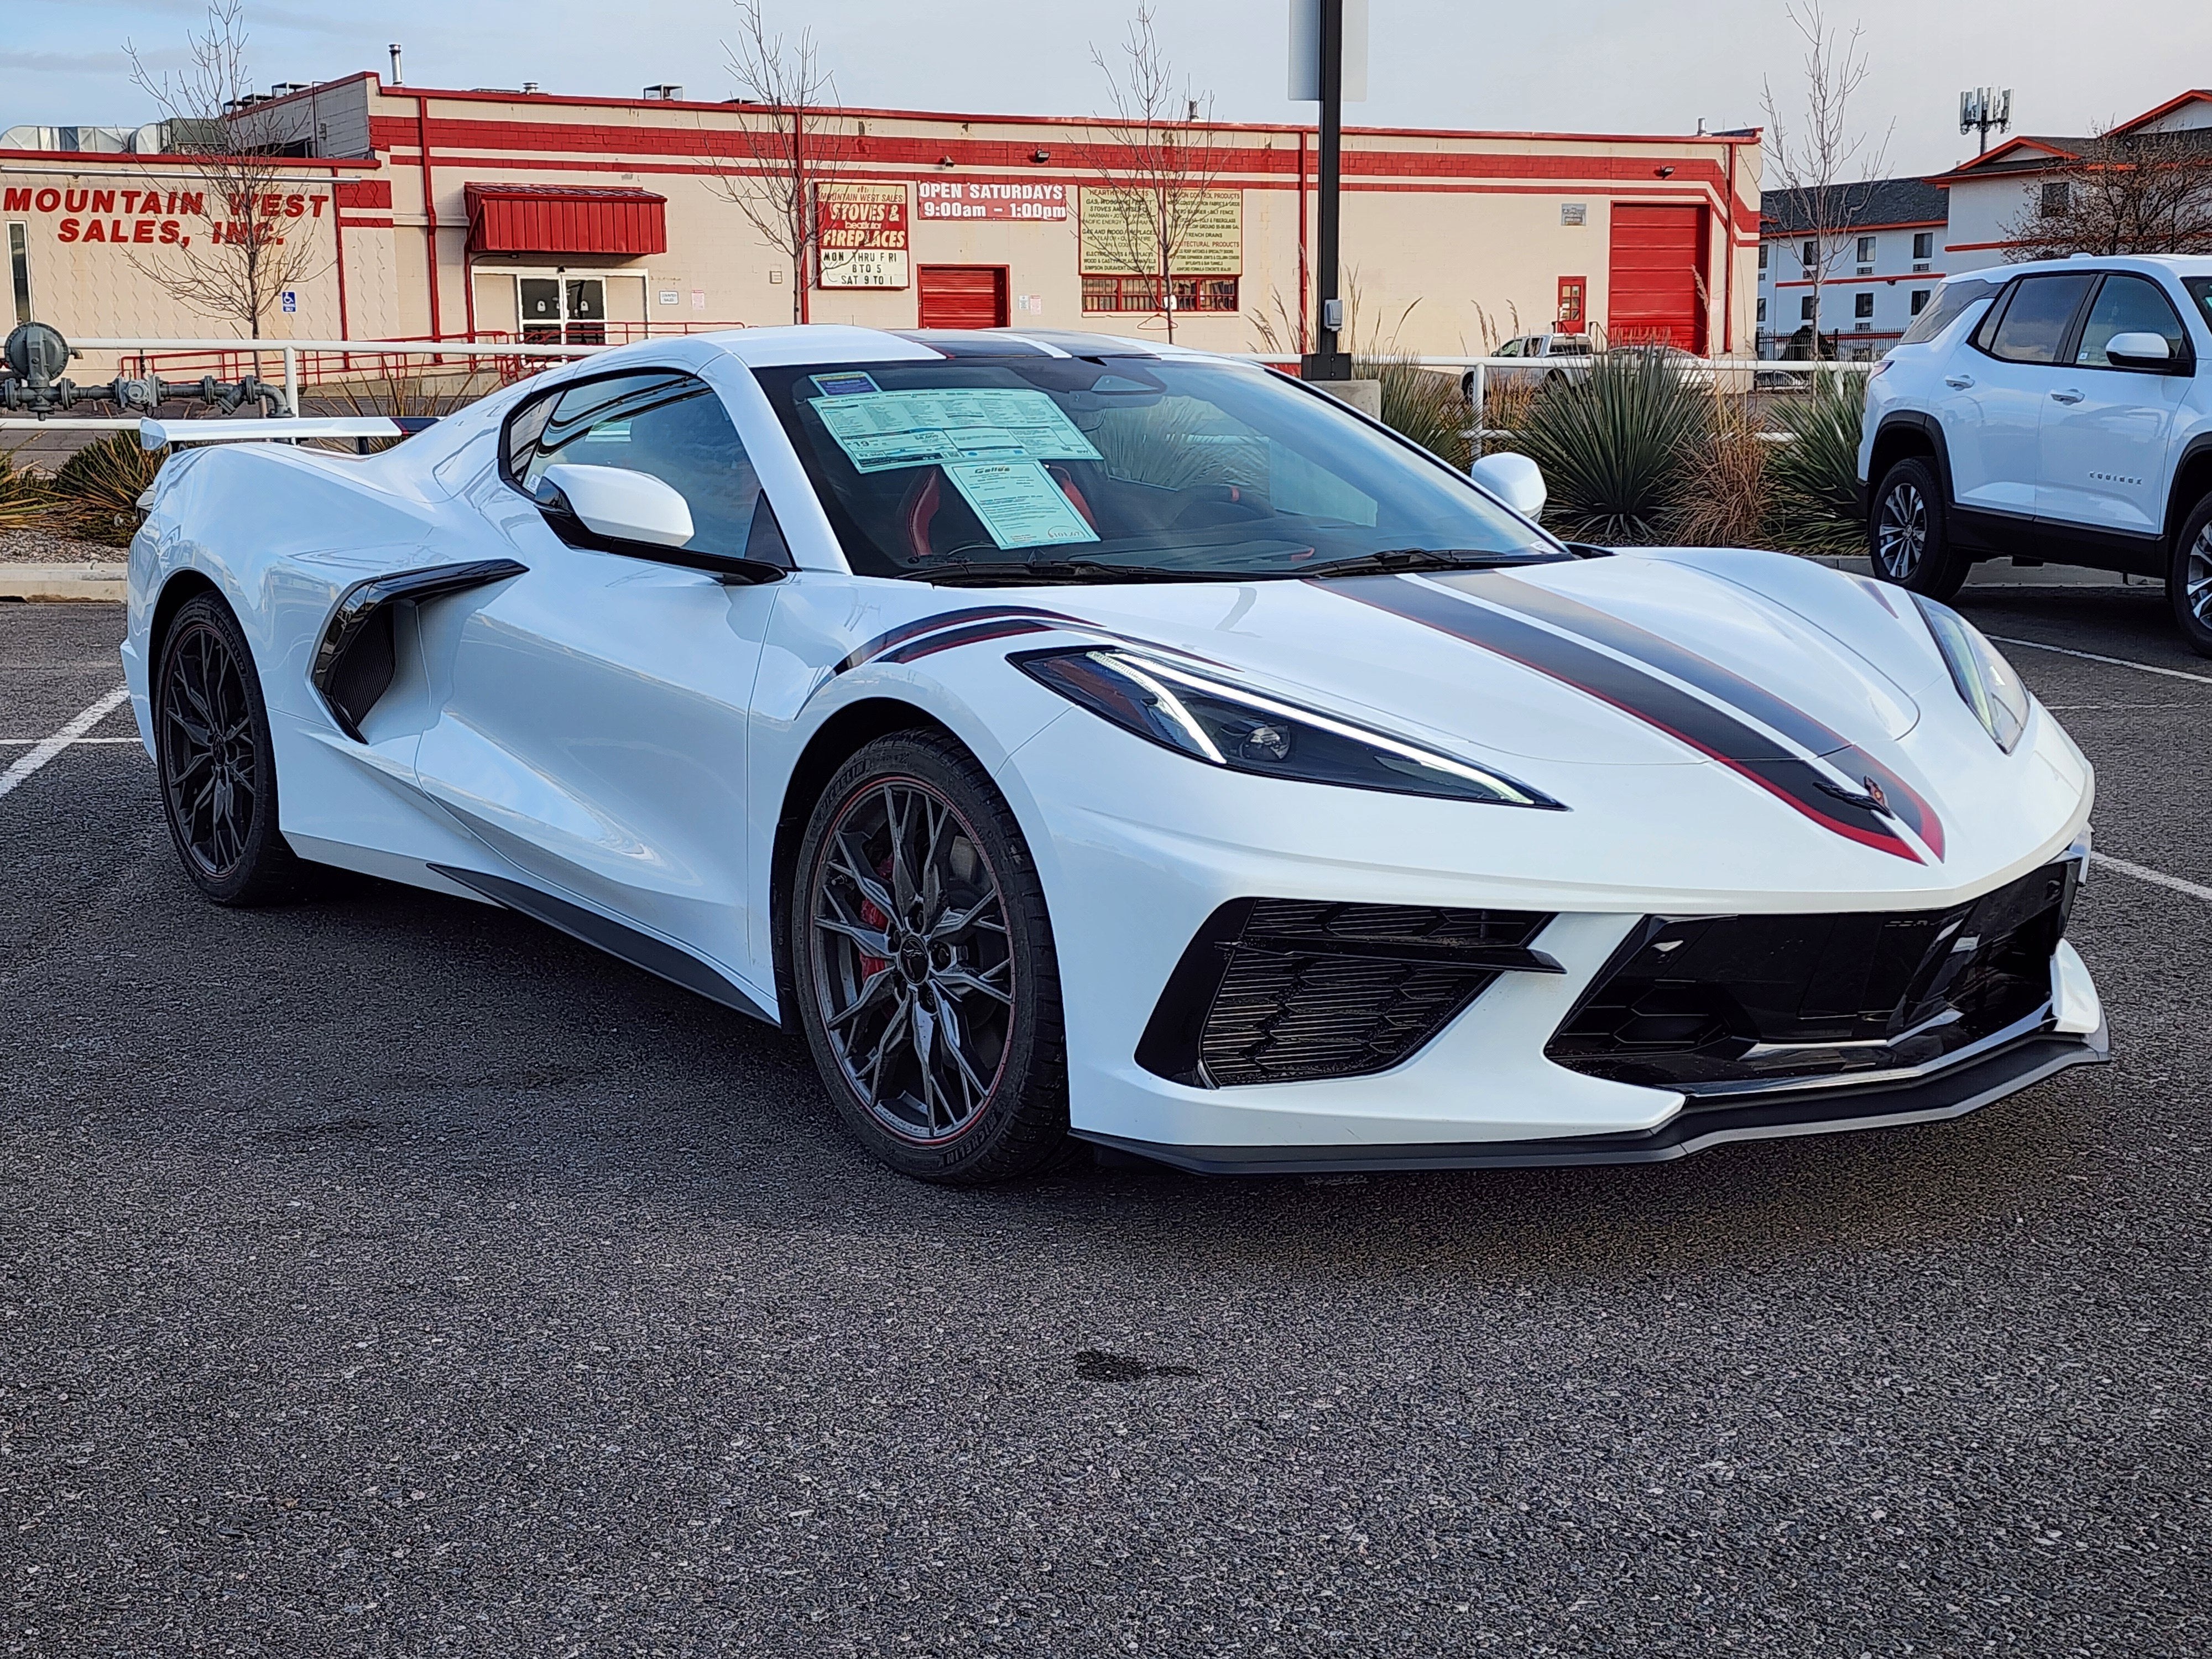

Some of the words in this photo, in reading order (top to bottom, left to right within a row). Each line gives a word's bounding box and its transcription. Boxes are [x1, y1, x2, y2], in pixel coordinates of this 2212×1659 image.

[860, 194, 880, 202] WEST
[919, 183, 962, 198] OPEN
[969, 185, 1063, 200] SATURDAYS
[3, 187, 204, 216] MOUNTAIN
[228, 193, 330, 218] WEST
[924, 201, 986, 217] 9:00am
[1010, 202, 1066, 219] 1:00pm
[831, 203, 885, 221] STOVES
[889, 205, 899, 221] &
[58, 218, 190, 248] SALES,
[212, 221, 284, 245] INC.
[823, 229, 905, 248] FIREPLACES
[823, 251, 844, 262] MON
[877, 264, 881, 273] 5
[841, 275, 858, 285] SAT
[864, 275, 869, 284] 9
[873, 276, 884, 285] TO
[2089, 471, 2142, 486] EQUINOX
[216, 620, 245, 671] MICHELIN
[817, 760, 867, 821] MICHELIN
[947, 1114, 997, 1165] MICHELIN
